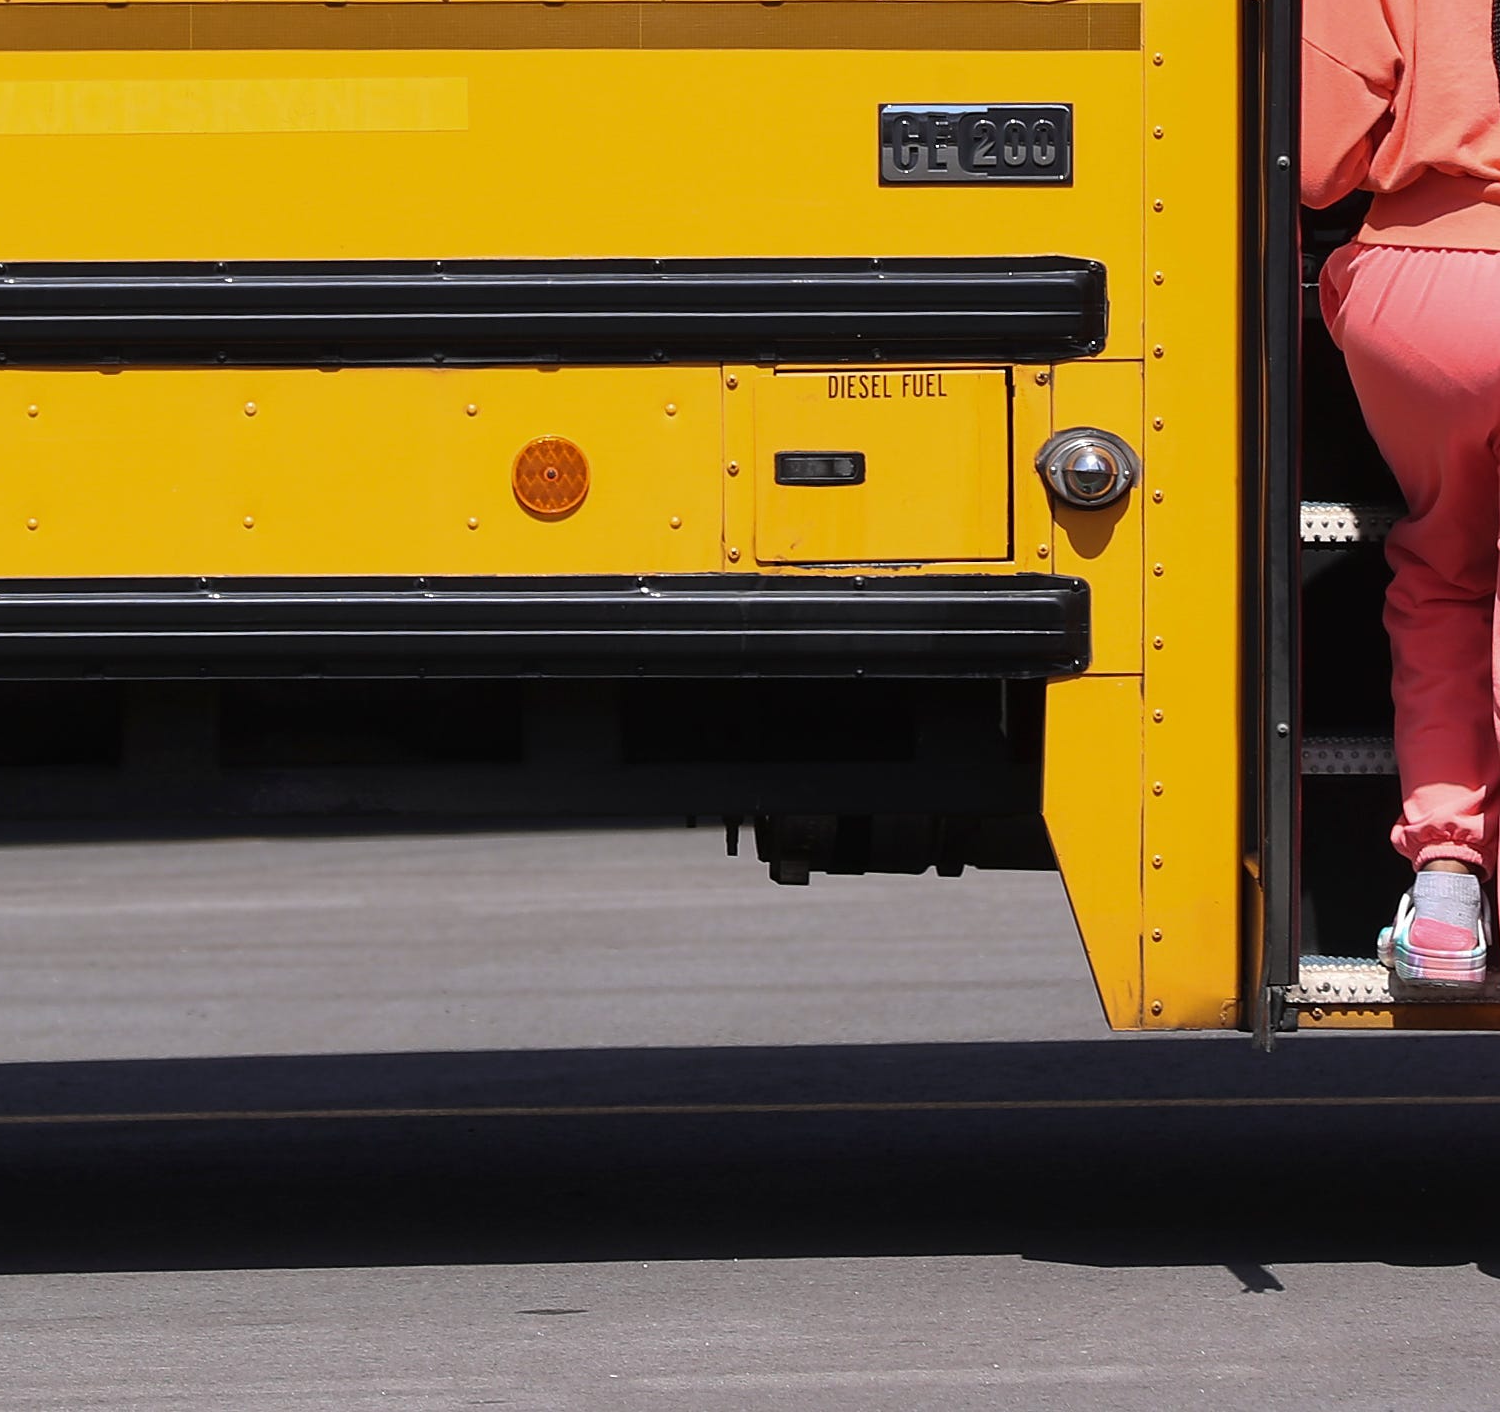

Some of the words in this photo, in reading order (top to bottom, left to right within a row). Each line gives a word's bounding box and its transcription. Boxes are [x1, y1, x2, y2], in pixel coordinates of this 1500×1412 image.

[892, 114, 949, 174] CE
[972, 118, 1056, 167] 200
[828, 374, 892, 399] DIESEL
[902, 373, 948, 398] FUEL
